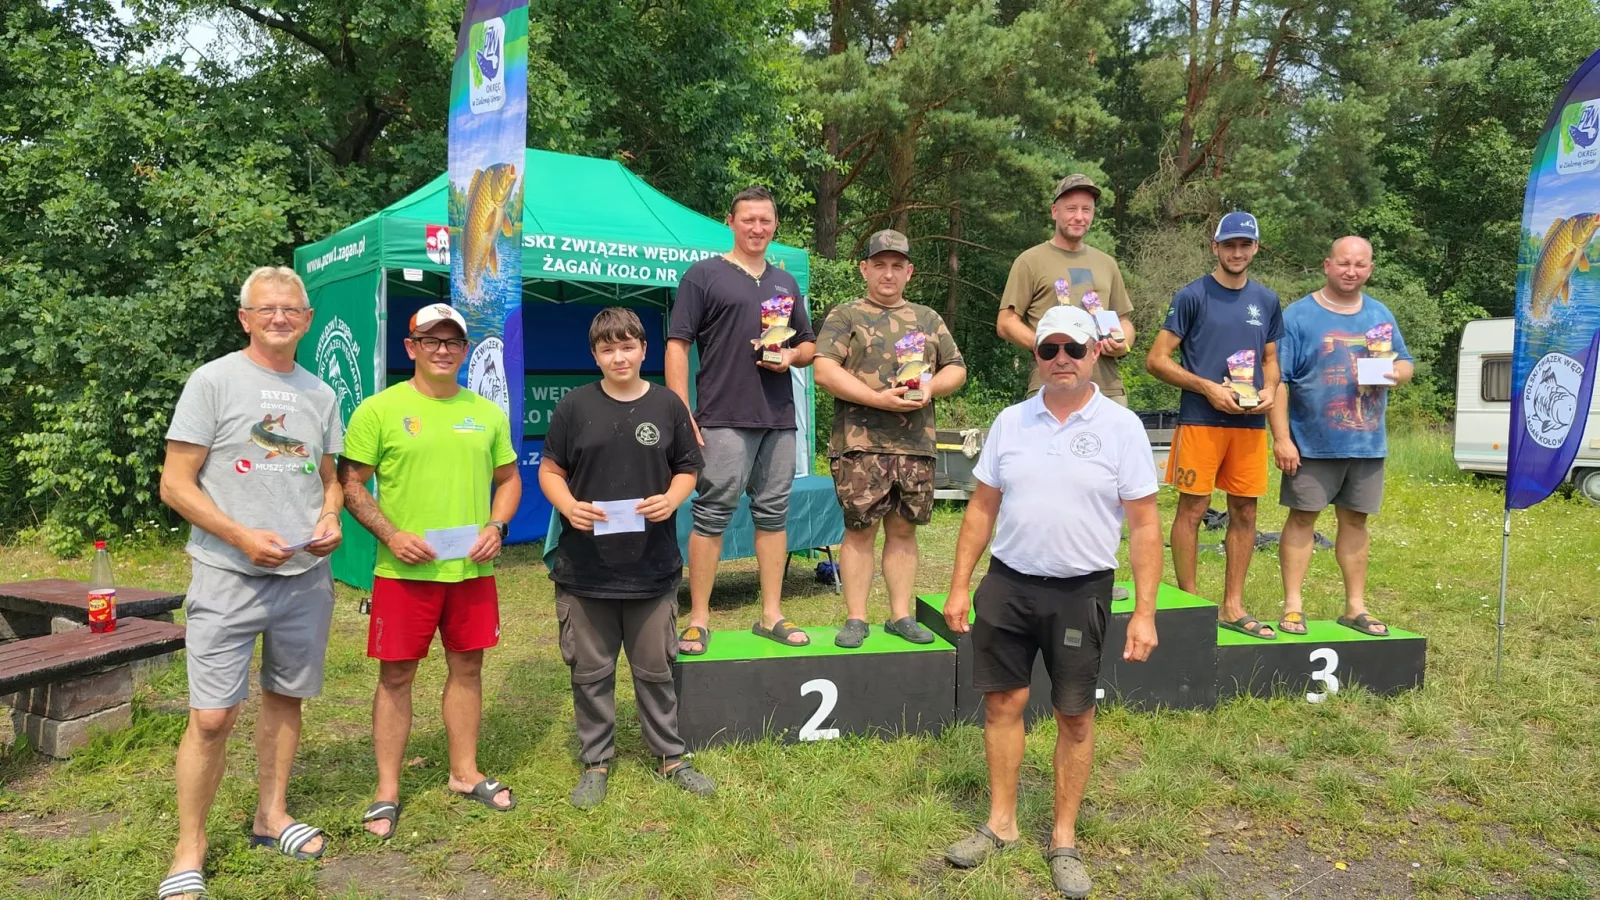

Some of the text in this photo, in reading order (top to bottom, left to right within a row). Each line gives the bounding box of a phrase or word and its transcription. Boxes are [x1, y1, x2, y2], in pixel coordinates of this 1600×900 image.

[521, 235, 556, 250] SKI
[561, 236, 639, 258] ZWIĄZEK
[542, 253, 678, 282] ŻAGAŃ KOŁO NR
[1526, 369, 1539, 401] POLSKI
[1538, 355, 1563, 372] ZWIĄZEK
[260, 389, 299, 403] RYBY
[1539, 435, 1558, 446] KOŁO
[255, 463, 284, 473] MUSZĘ
[1177, 467, 1197, 488] 20
[1306, 647, 1340, 704] 3
[799, 678, 840, 742] 2
